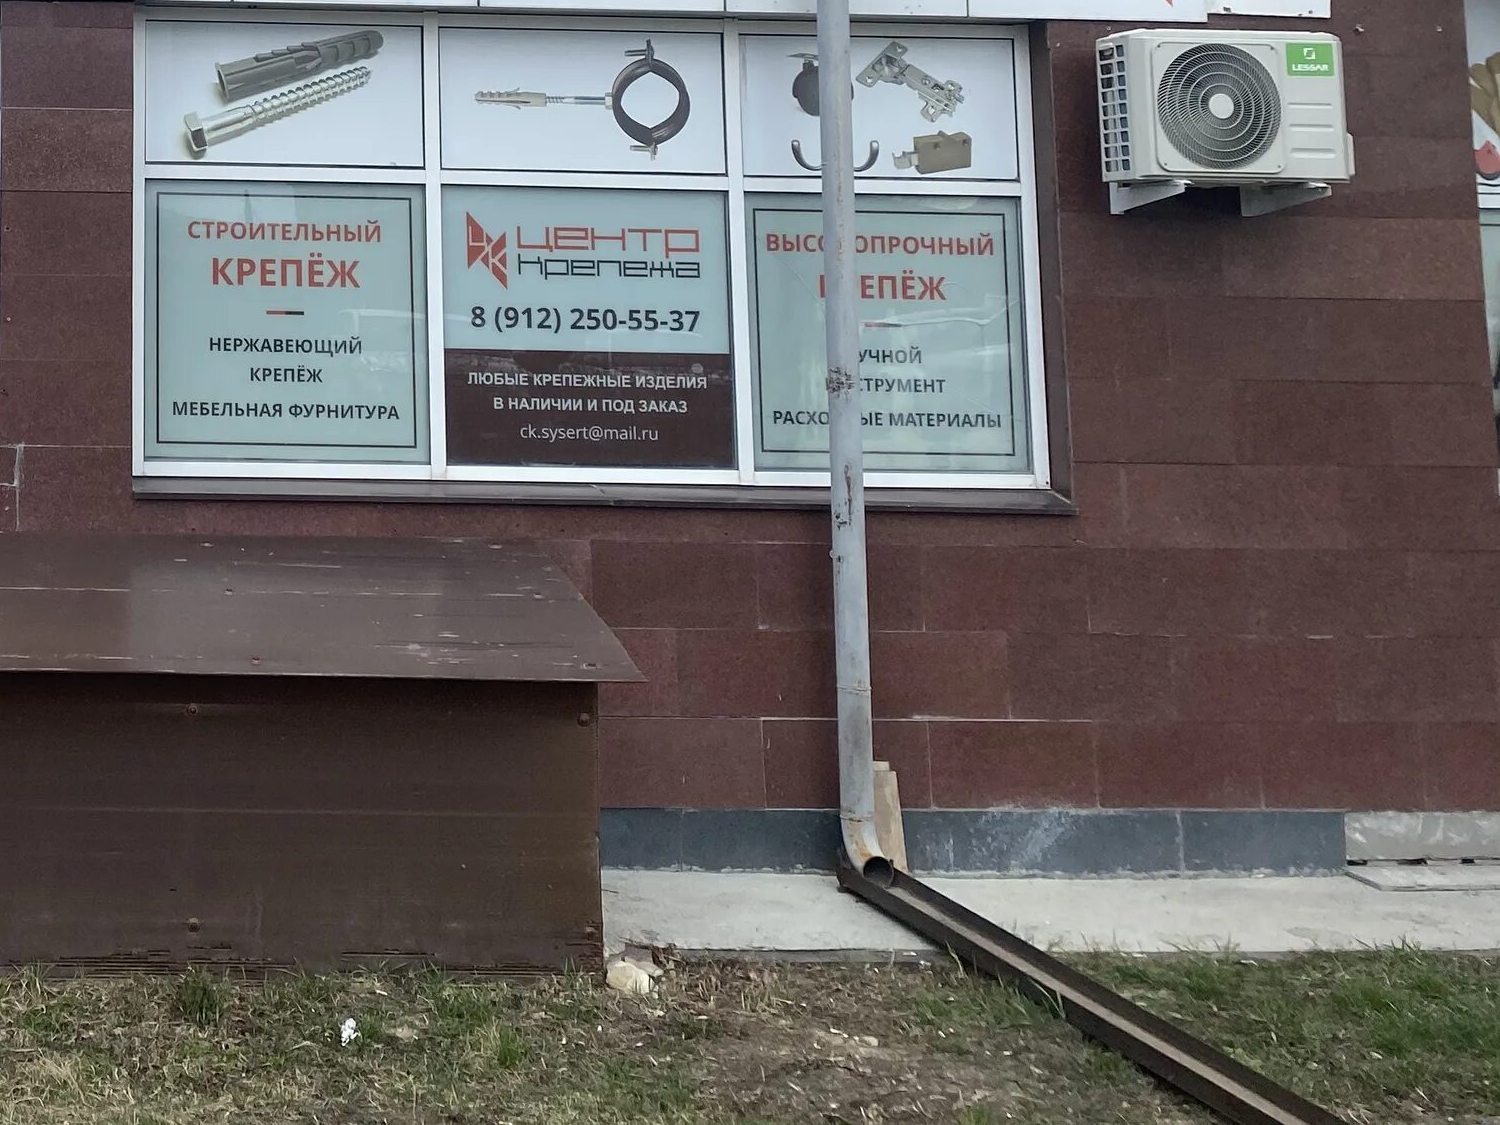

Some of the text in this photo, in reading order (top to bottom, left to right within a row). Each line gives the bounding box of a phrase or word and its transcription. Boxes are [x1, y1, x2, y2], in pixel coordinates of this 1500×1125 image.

[1292, 63, 1329, 72] LESSAR
[187, 220, 381, 243] СТРОИТЕЛЬНЫЙ
[766, 232, 994, 256] ВЫСОПРОЧНЫЙ
[212, 252, 361, 288] КРЕПЁЖ
[819, 269, 947, 300] ЕПЁЖ
[471, 306, 701, 334] 8 (912) 250-55-37
[209, 336, 362, 357] НЕРЖАВЕЮЩИЙ
[858, 346, 922, 364] УЧНОЙ
[250, 365, 323, 383] КРЕПЁЖ
[467, 372, 708, 390] ЛЮБЫЕ КРЕПЕЖНЫЕ ИЗДЕЛИЯ
[172, 401, 400, 420] МЕБЕЛЬНАЯ ФУРНИТУРА
[493, 397, 688, 414] В НАЛИЧИИ И ПОД ЗАКАЗ
[773, 410, 1002, 428] РАСХОЫЕ МАТЕРИАЛЫ
[520, 424, 659, 442] ck.sysert@mail.ru
